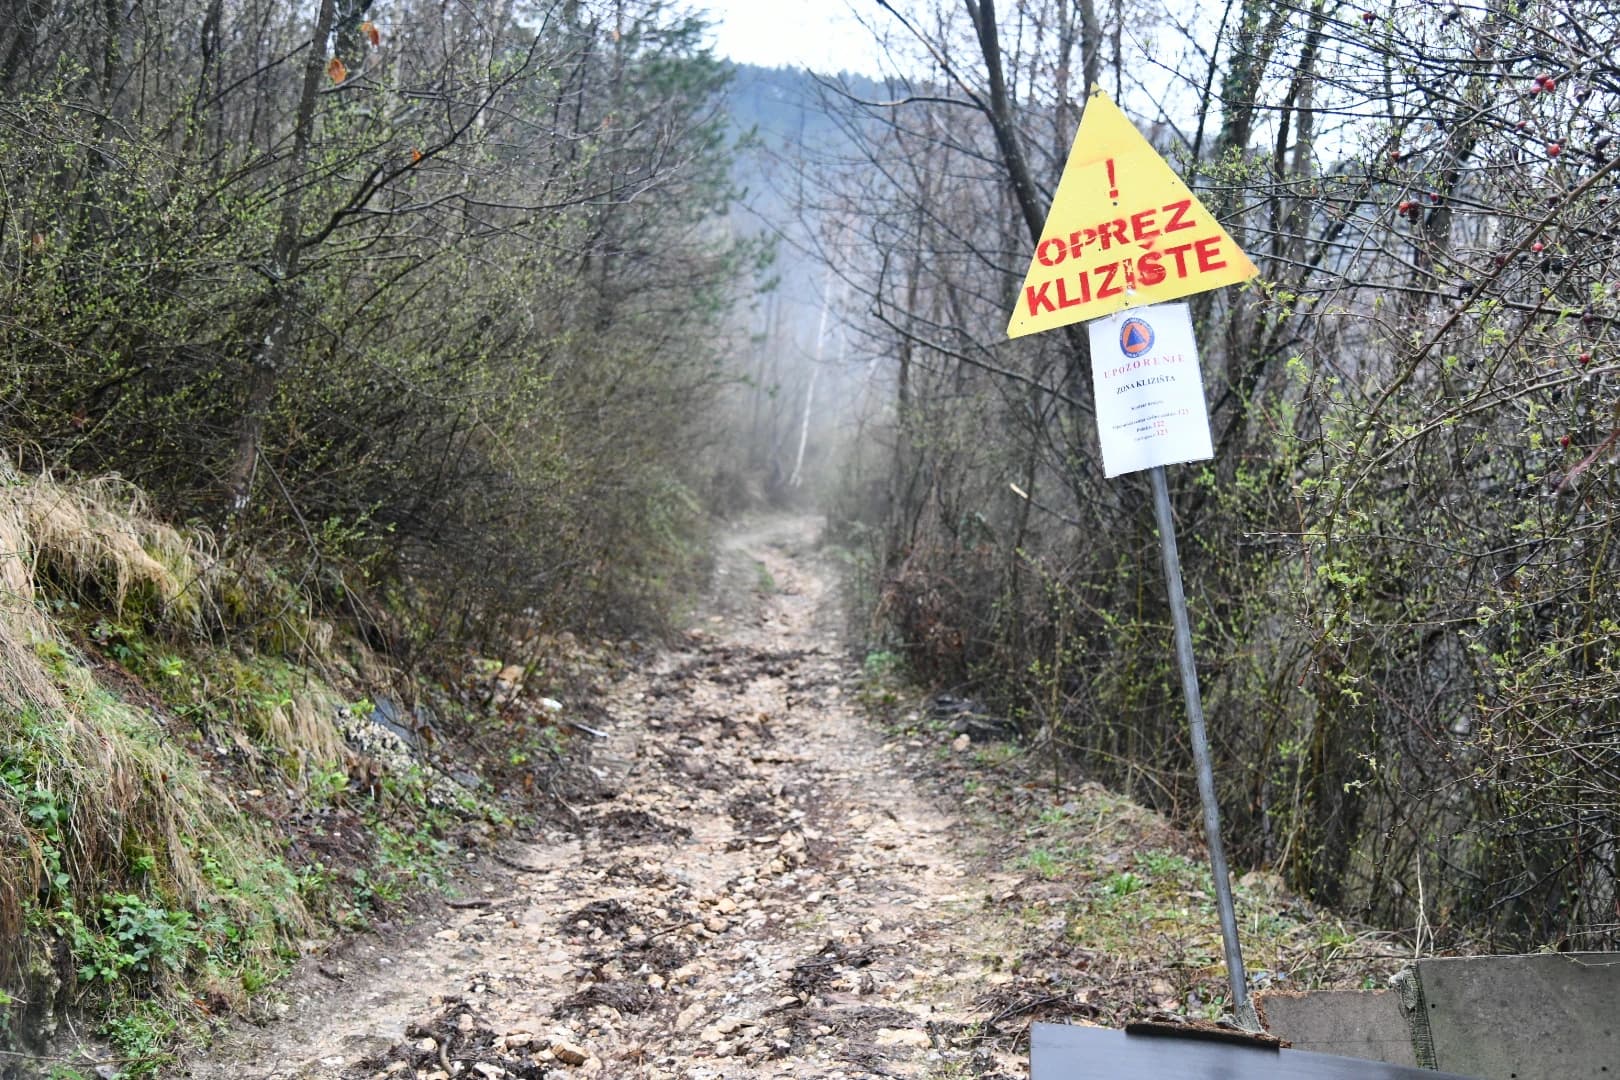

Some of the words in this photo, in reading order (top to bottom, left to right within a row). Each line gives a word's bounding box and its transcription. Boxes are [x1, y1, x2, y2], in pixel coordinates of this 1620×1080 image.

[1037, 199, 1196, 267] OPREZ
[1025, 235, 1227, 316] KLIZIŠTE
[1116, 383, 1135, 395] ZONA
[1136, 375, 1175, 389] KLIZIŠTA
